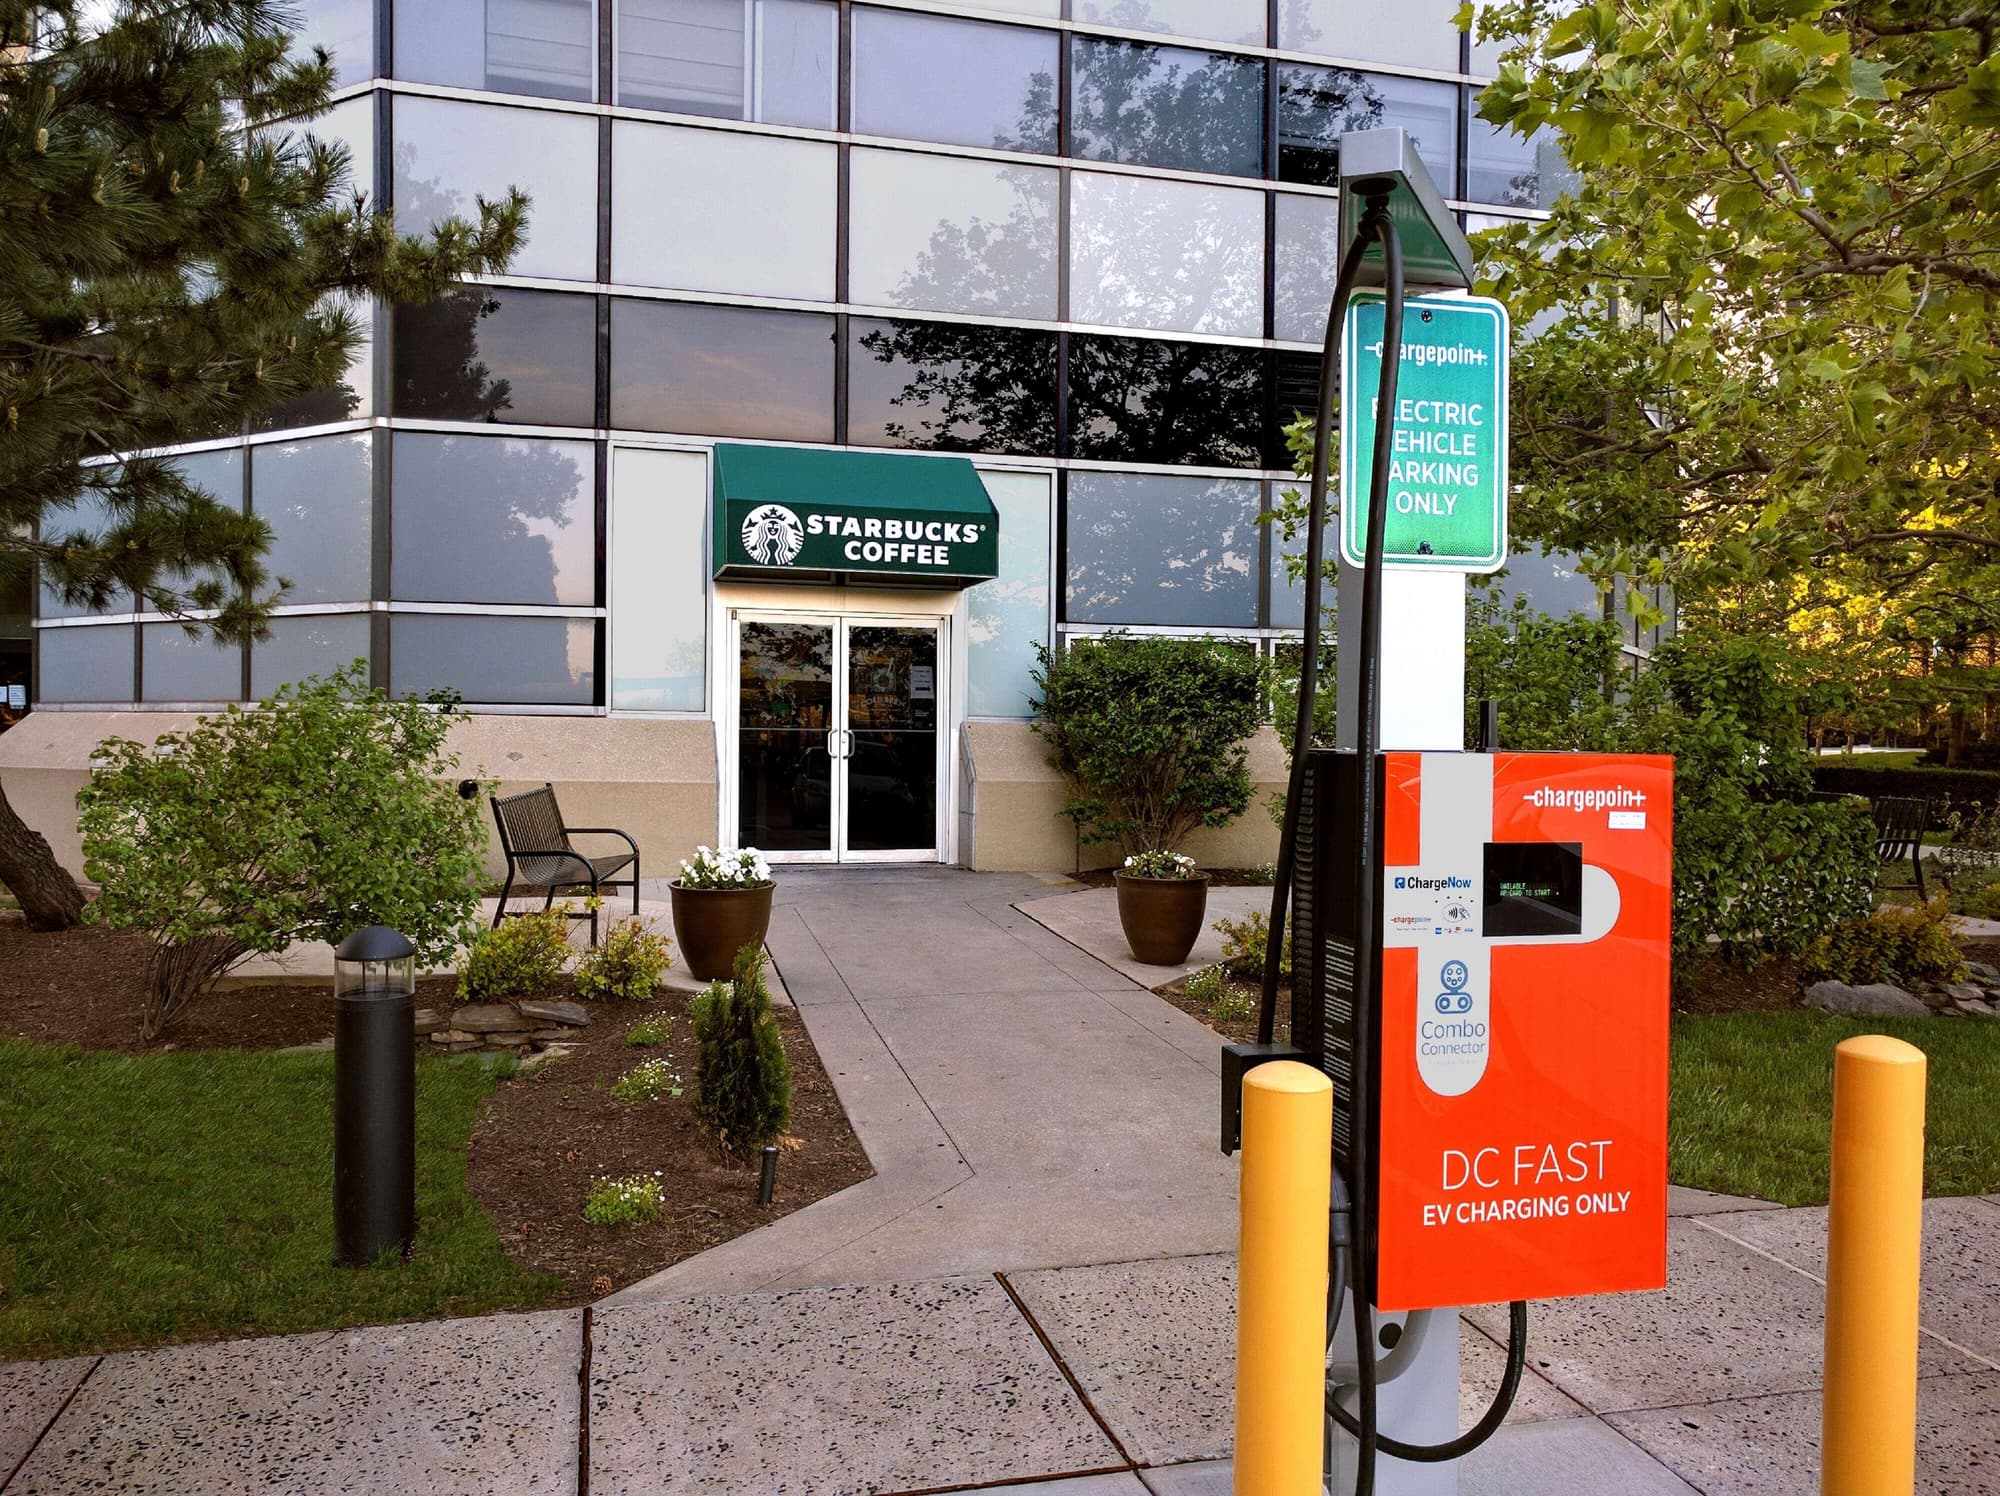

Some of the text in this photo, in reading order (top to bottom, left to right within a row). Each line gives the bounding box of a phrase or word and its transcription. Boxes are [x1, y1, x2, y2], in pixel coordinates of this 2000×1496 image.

[1365, 341, 1488, 367] cargepoint
[1371, 397, 1483, 426] ECTRIC
[1394, 430, 1477, 456] EHICLE
[1389, 461, 1479, 487] ARKING
[1395, 490, 1458, 515] ONLY
[844, 540, 949, 566] COFFEE
[1523, 785, 1646, 812] chargepoint
[1407, 876, 1472, 891] ChargeNow
[1421, 1019, 1486, 1039] Combo
[1421, 1042, 1486, 1056] Connector
[1442, 1140, 1613, 1190] DC FAST
[1423, 1191, 1631, 1226] EV CHARGING ONLY
